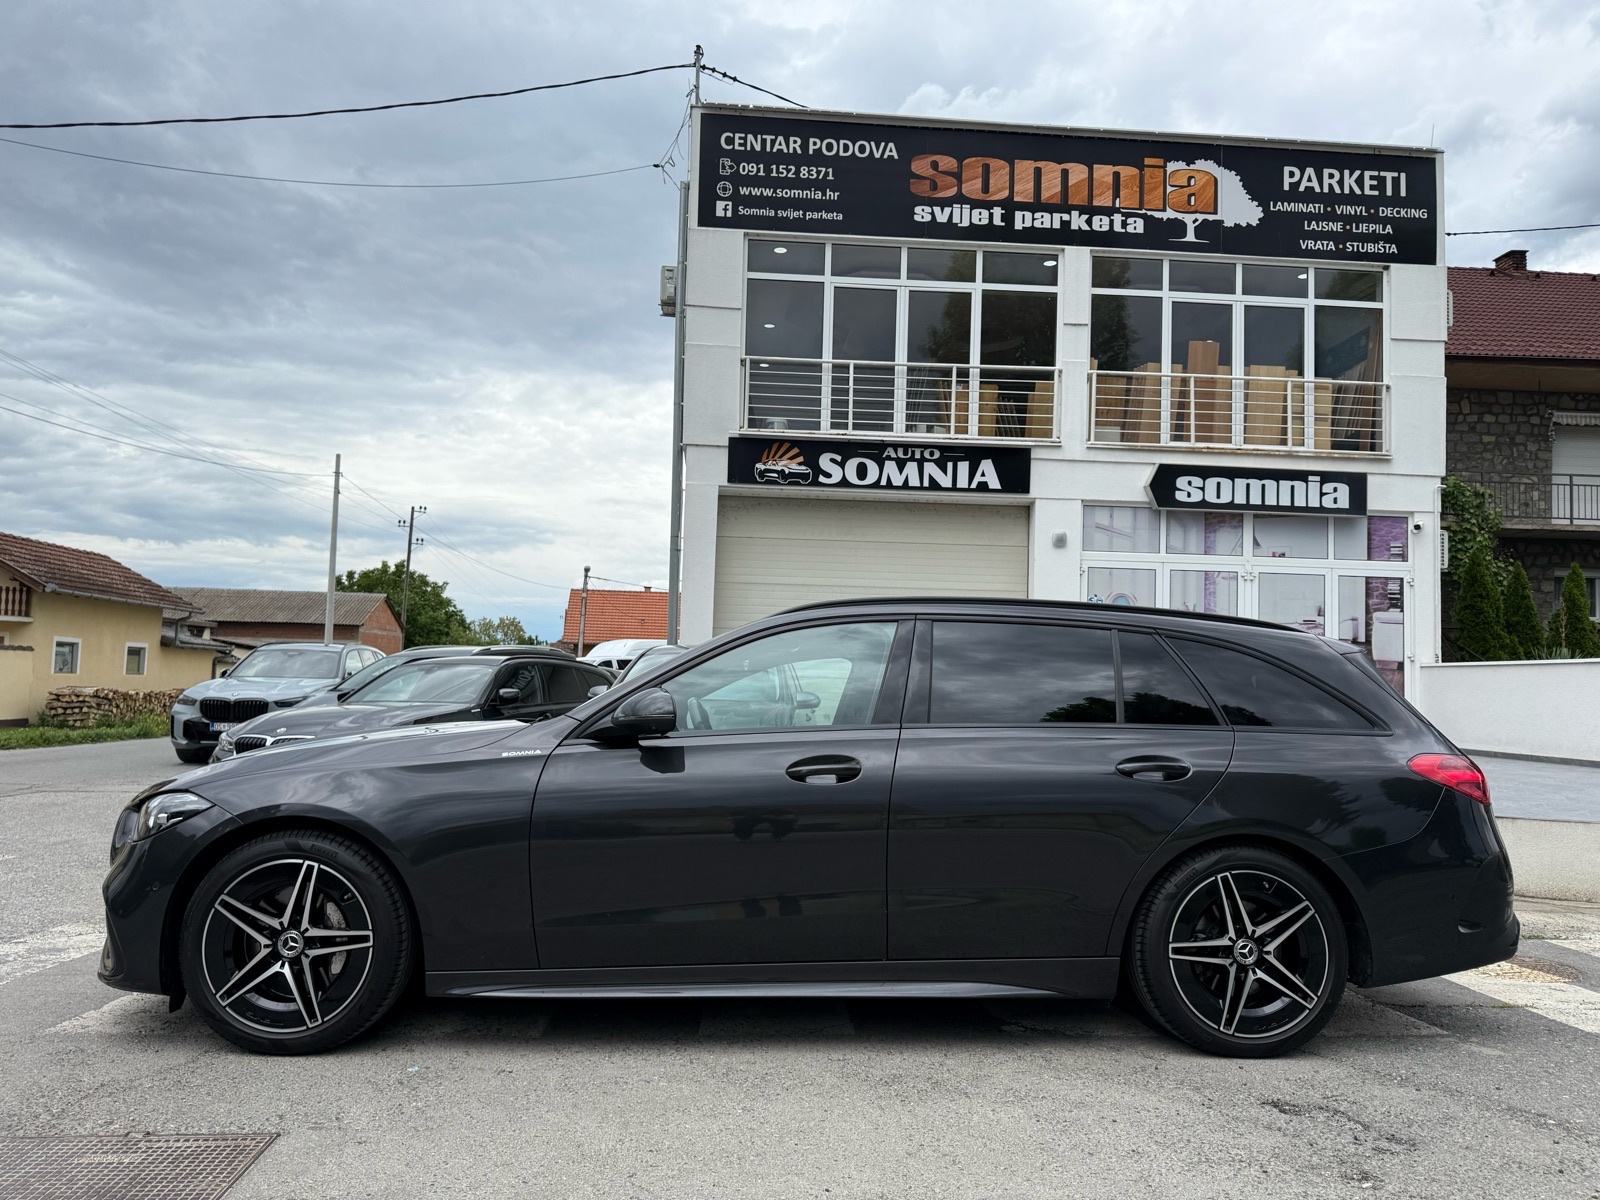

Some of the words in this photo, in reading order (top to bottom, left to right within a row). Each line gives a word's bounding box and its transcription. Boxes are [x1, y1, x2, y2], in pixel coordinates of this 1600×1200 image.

[720, 132, 802, 154] CENTAR
[808, 137, 899, 160] PODOVA
[739, 162, 766, 177] 091
[770, 164, 796, 178] 152
[799, 166, 835, 180] 8371
[909, 152, 1218, 214] somnia
[1283, 165, 1407, 197] PARKETI
[739, 186, 840, 201] www.somnia.hr
[738, 205, 774, 217] Somnia
[777, 208, 804, 220] svijet
[805, 210, 843, 221] parketa
[913, 203, 1005, 227] svijet
[1014, 209, 1145, 234] parketa
[1270, 201, 1324, 214] LAMINATI
[1335, 205, 1368, 216] VINYL
[1379, 206, 1428, 219] DECKING
[1304, 220, 1343, 232] LAJSNE
[1352, 222, 1393, 235] LJEPILA
[1299, 239, 1336, 251] VRATA
[1345, 241, 1398, 254] STUBIŠTA
[882, 447, 941, 460] AUTO
[818, 452, 1002, 490] SOMNIA
[1174, 475, 1350, 509] somnia
[502, 749, 542, 757] SOMNIA
